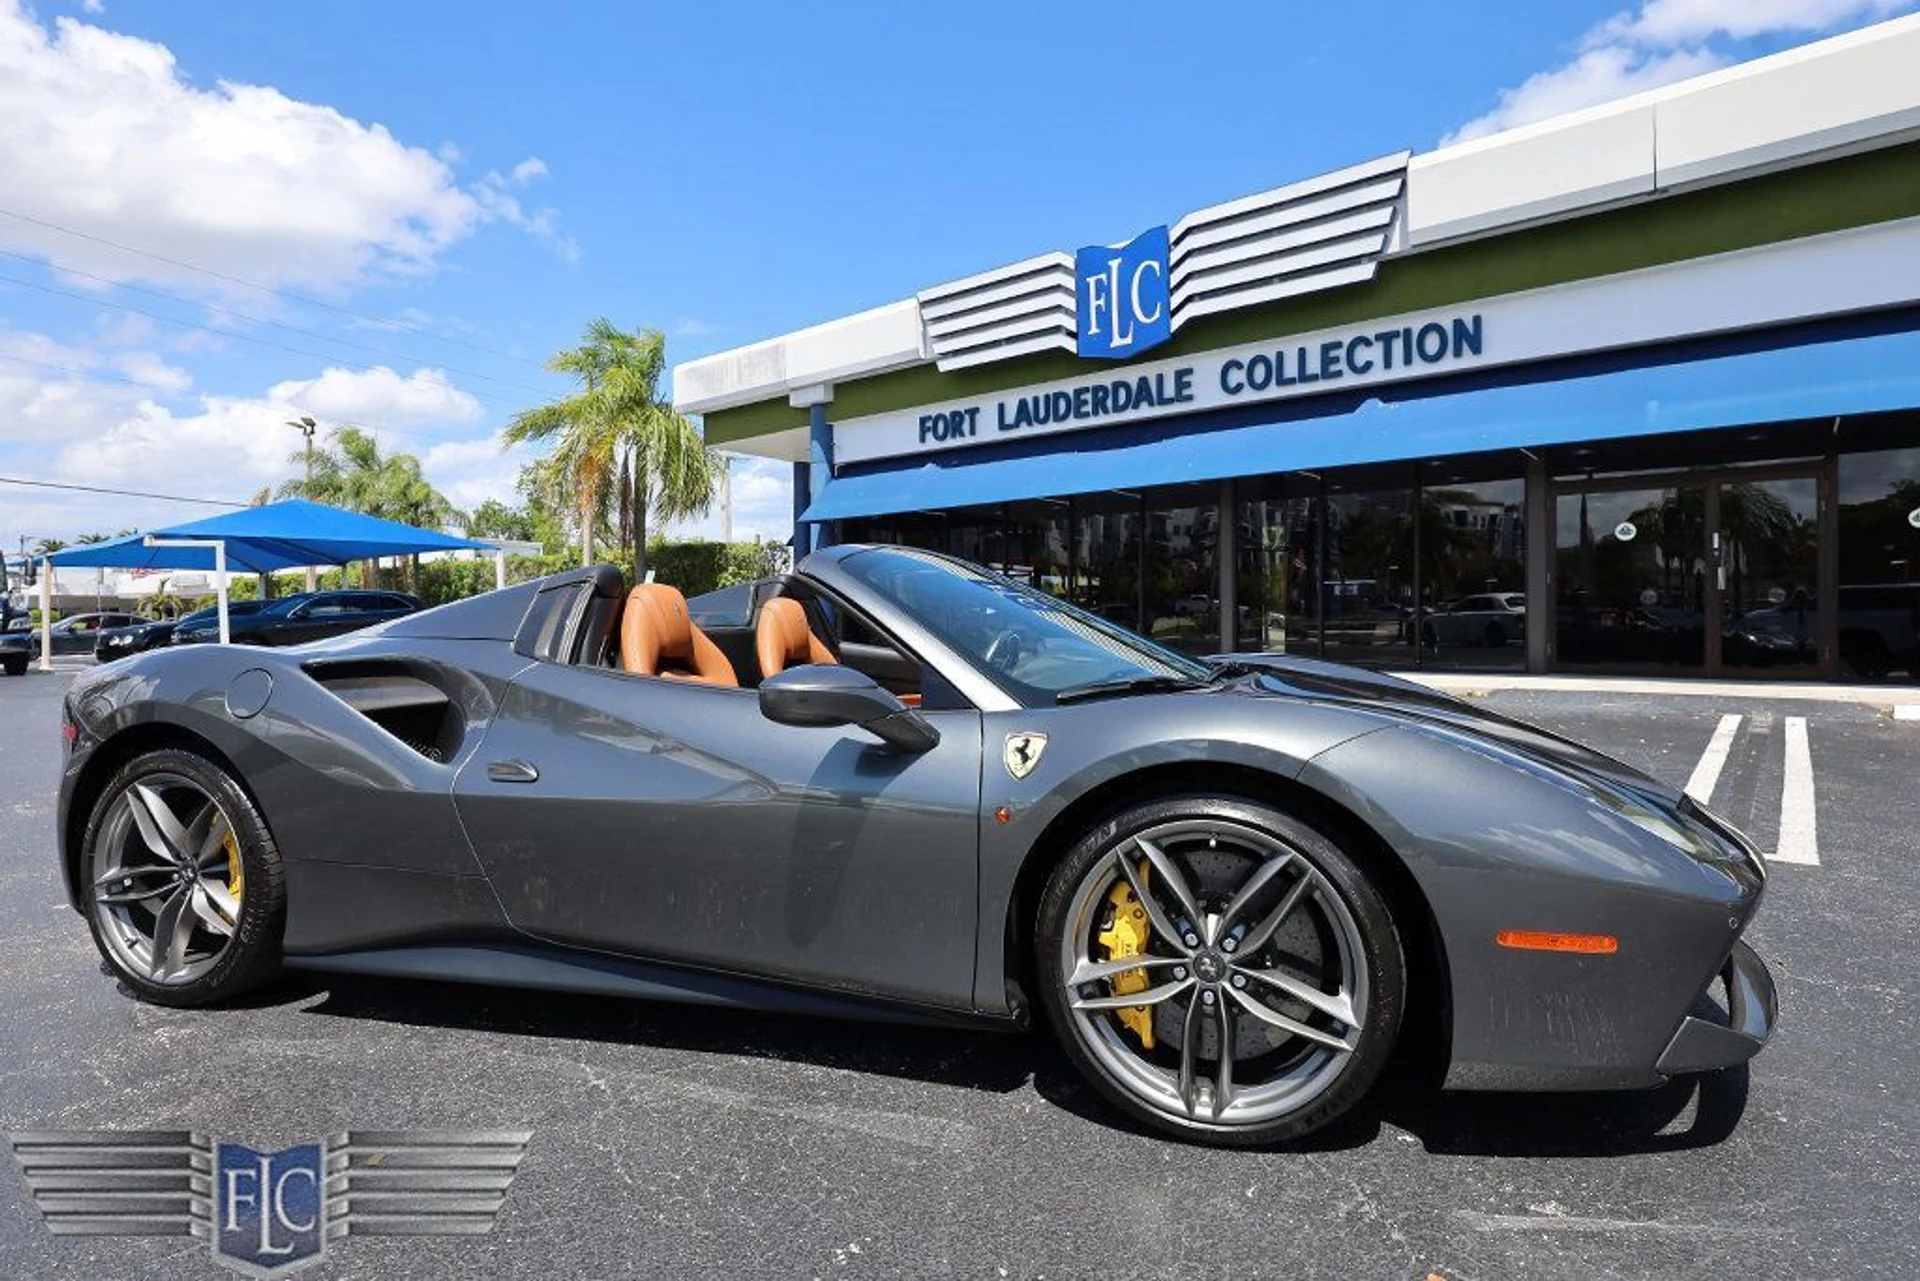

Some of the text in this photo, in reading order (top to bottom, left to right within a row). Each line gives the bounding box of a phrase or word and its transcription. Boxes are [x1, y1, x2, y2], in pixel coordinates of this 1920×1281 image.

[1086, 257, 1161, 348] FLC
[918, 315, 1482, 443] FORT LAUDERDALE COLLECTION
